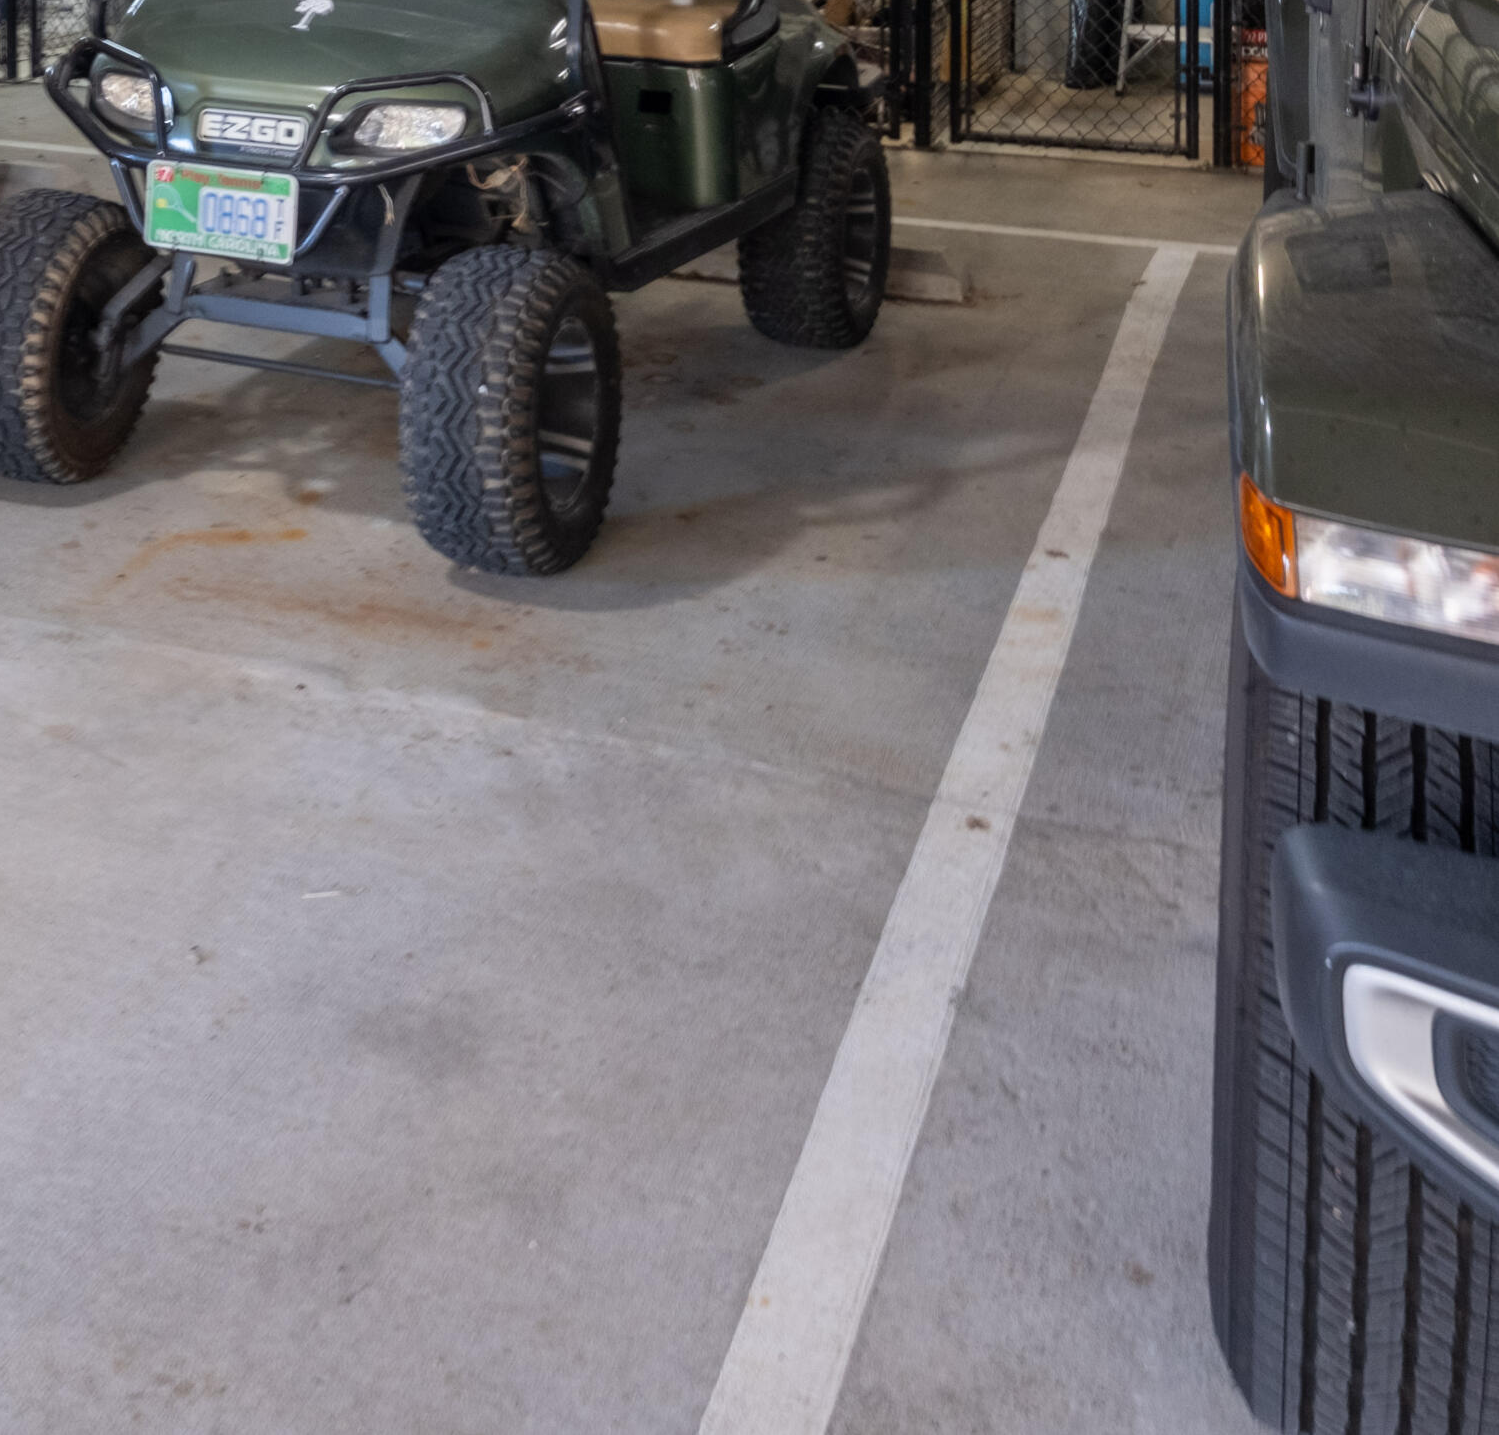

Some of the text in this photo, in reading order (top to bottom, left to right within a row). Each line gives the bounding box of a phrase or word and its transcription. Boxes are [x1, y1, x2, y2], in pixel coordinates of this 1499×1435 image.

[201, 113, 305, 146] EZGO
[202, 191, 268, 239] 0868
[155, 228, 280, 257] NORTH CAROLINA
